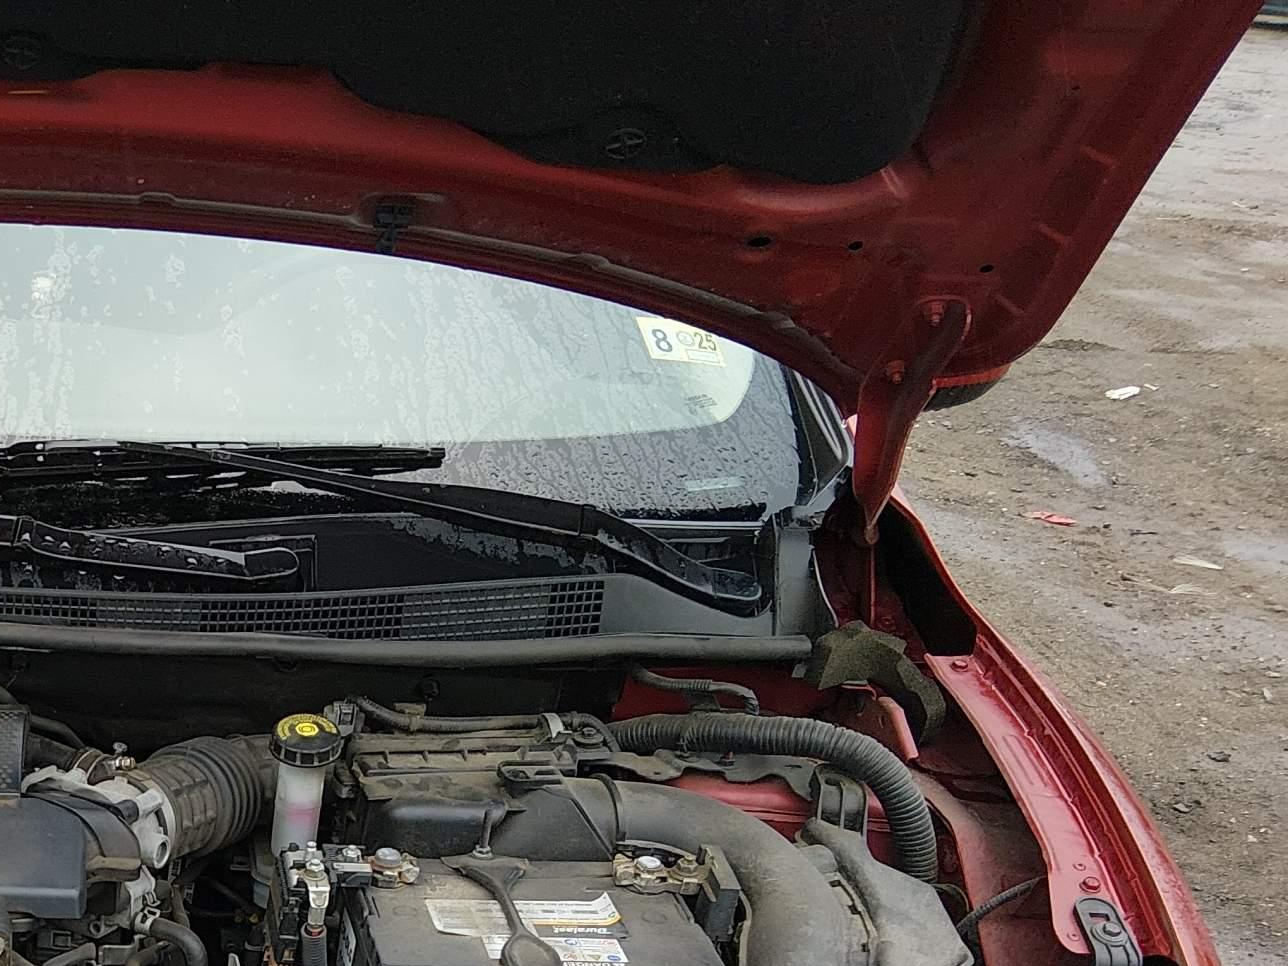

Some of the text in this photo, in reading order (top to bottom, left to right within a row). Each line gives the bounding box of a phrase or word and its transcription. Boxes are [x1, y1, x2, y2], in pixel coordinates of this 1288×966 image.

[652, 329, 716, 352] 8 25
[552, 926, 610, 935] Duralast
